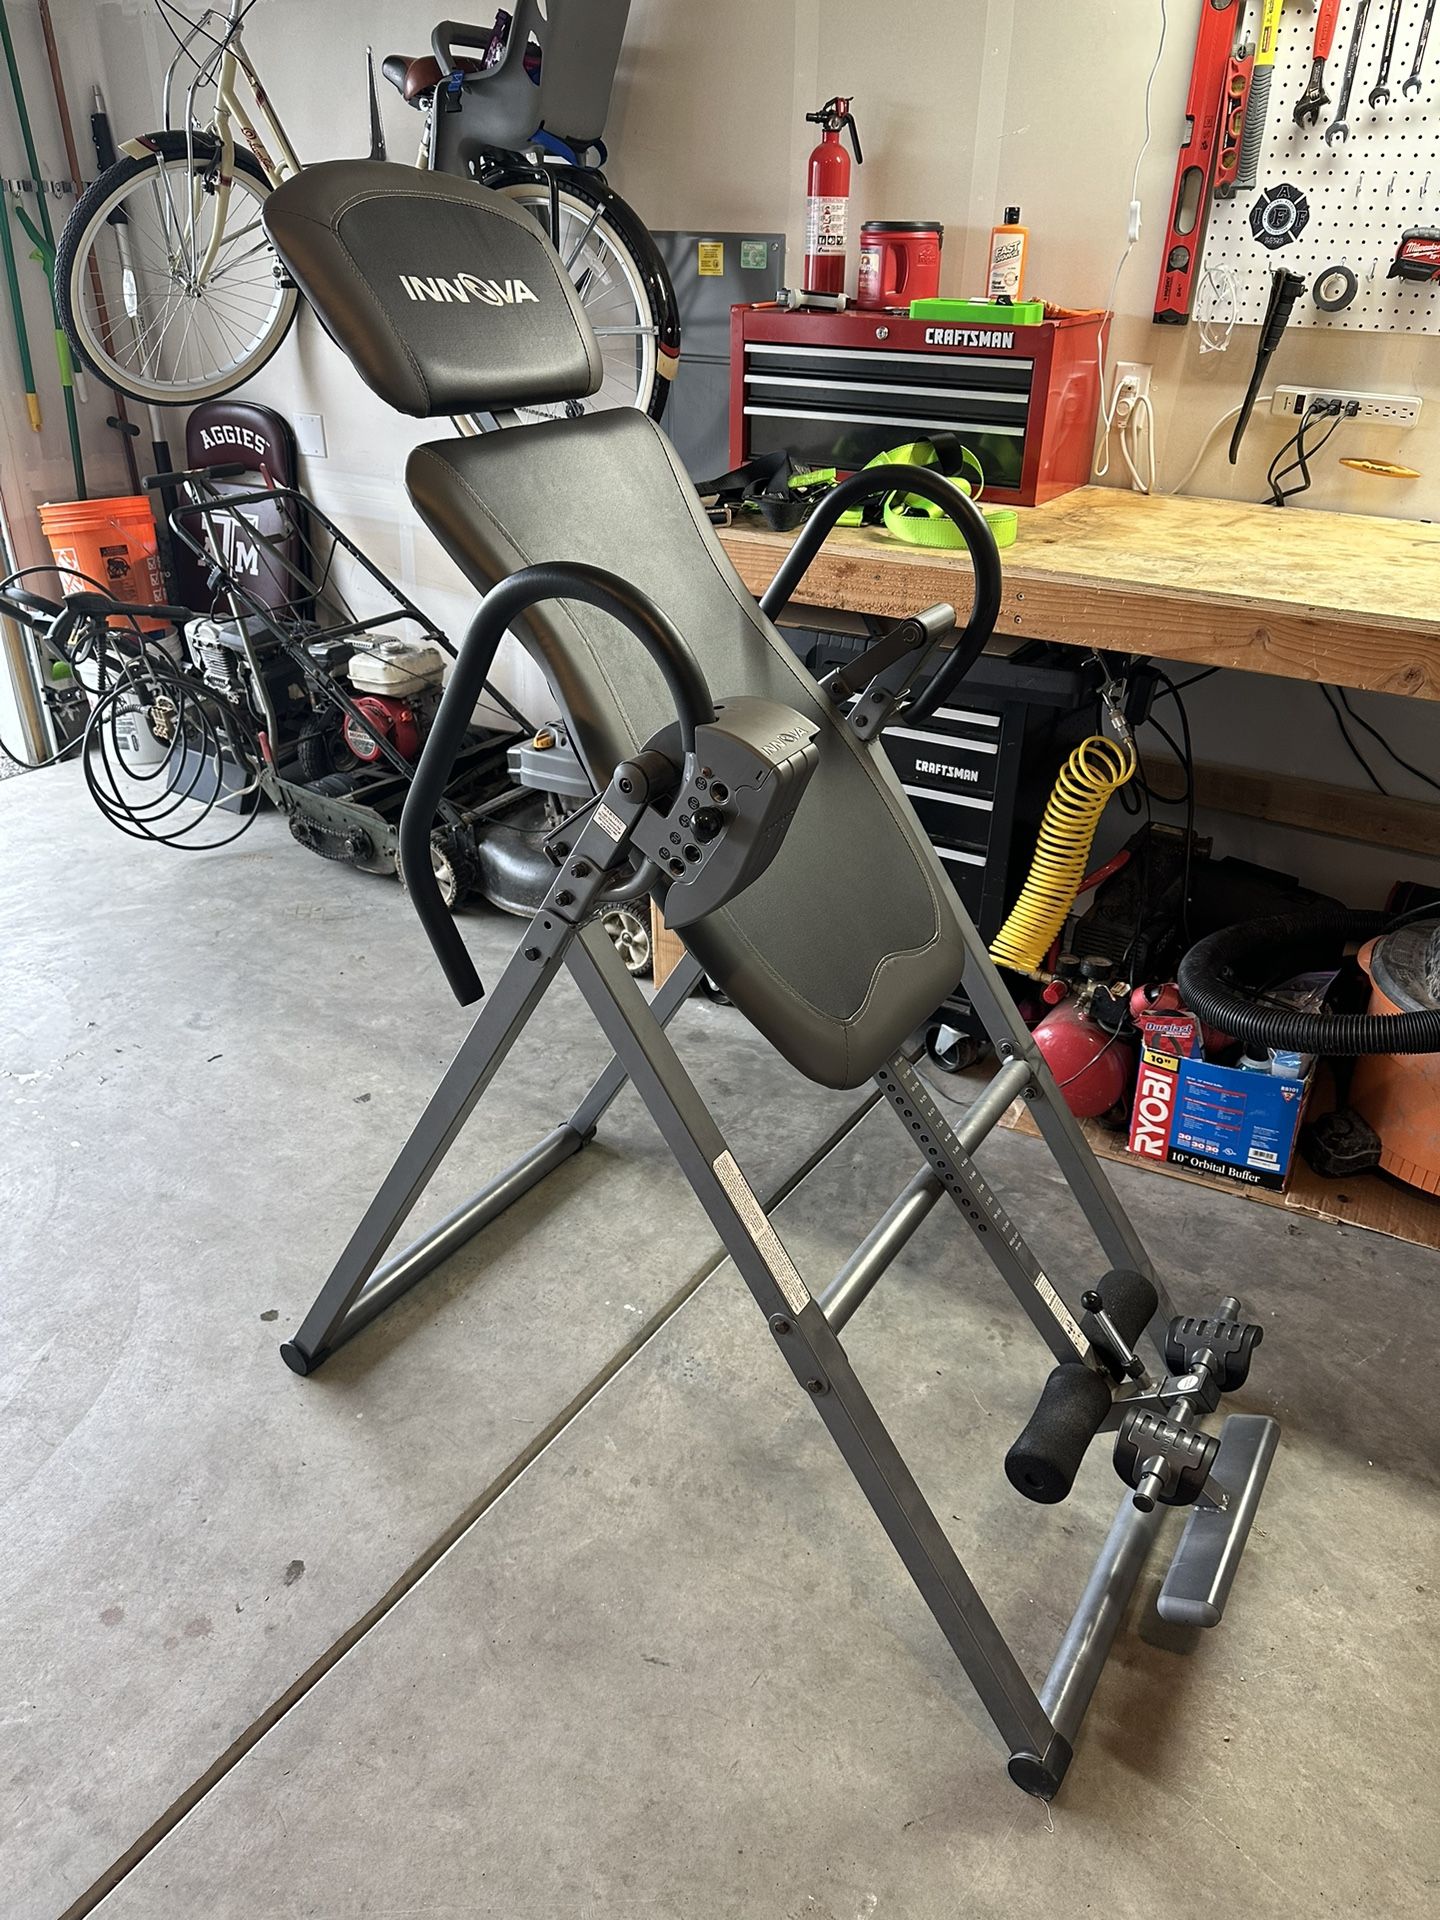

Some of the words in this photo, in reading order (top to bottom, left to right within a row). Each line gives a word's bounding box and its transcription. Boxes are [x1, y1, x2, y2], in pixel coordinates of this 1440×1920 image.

[399, 272, 540, 307] INNOVA
[925, 327, 1015, 349] CRAFTSMAN
[200, 425, 267, 456] AGGIES
[761, 726, 808, 756] INNOVA
[915, 759, 979, 782] CRAFTSMAN
[1146, 1022, 1193, 1034] Duralast
[1151, 1055, 1171, 1065] 10"
[1134, 1069, 1173, 1156] RYOBI
[1172, 1151, 1189, 1163] 10"
[1190, 1157, 1226, 1175] Orbital
[1228, 1167, 1261, 1183] Buffer
